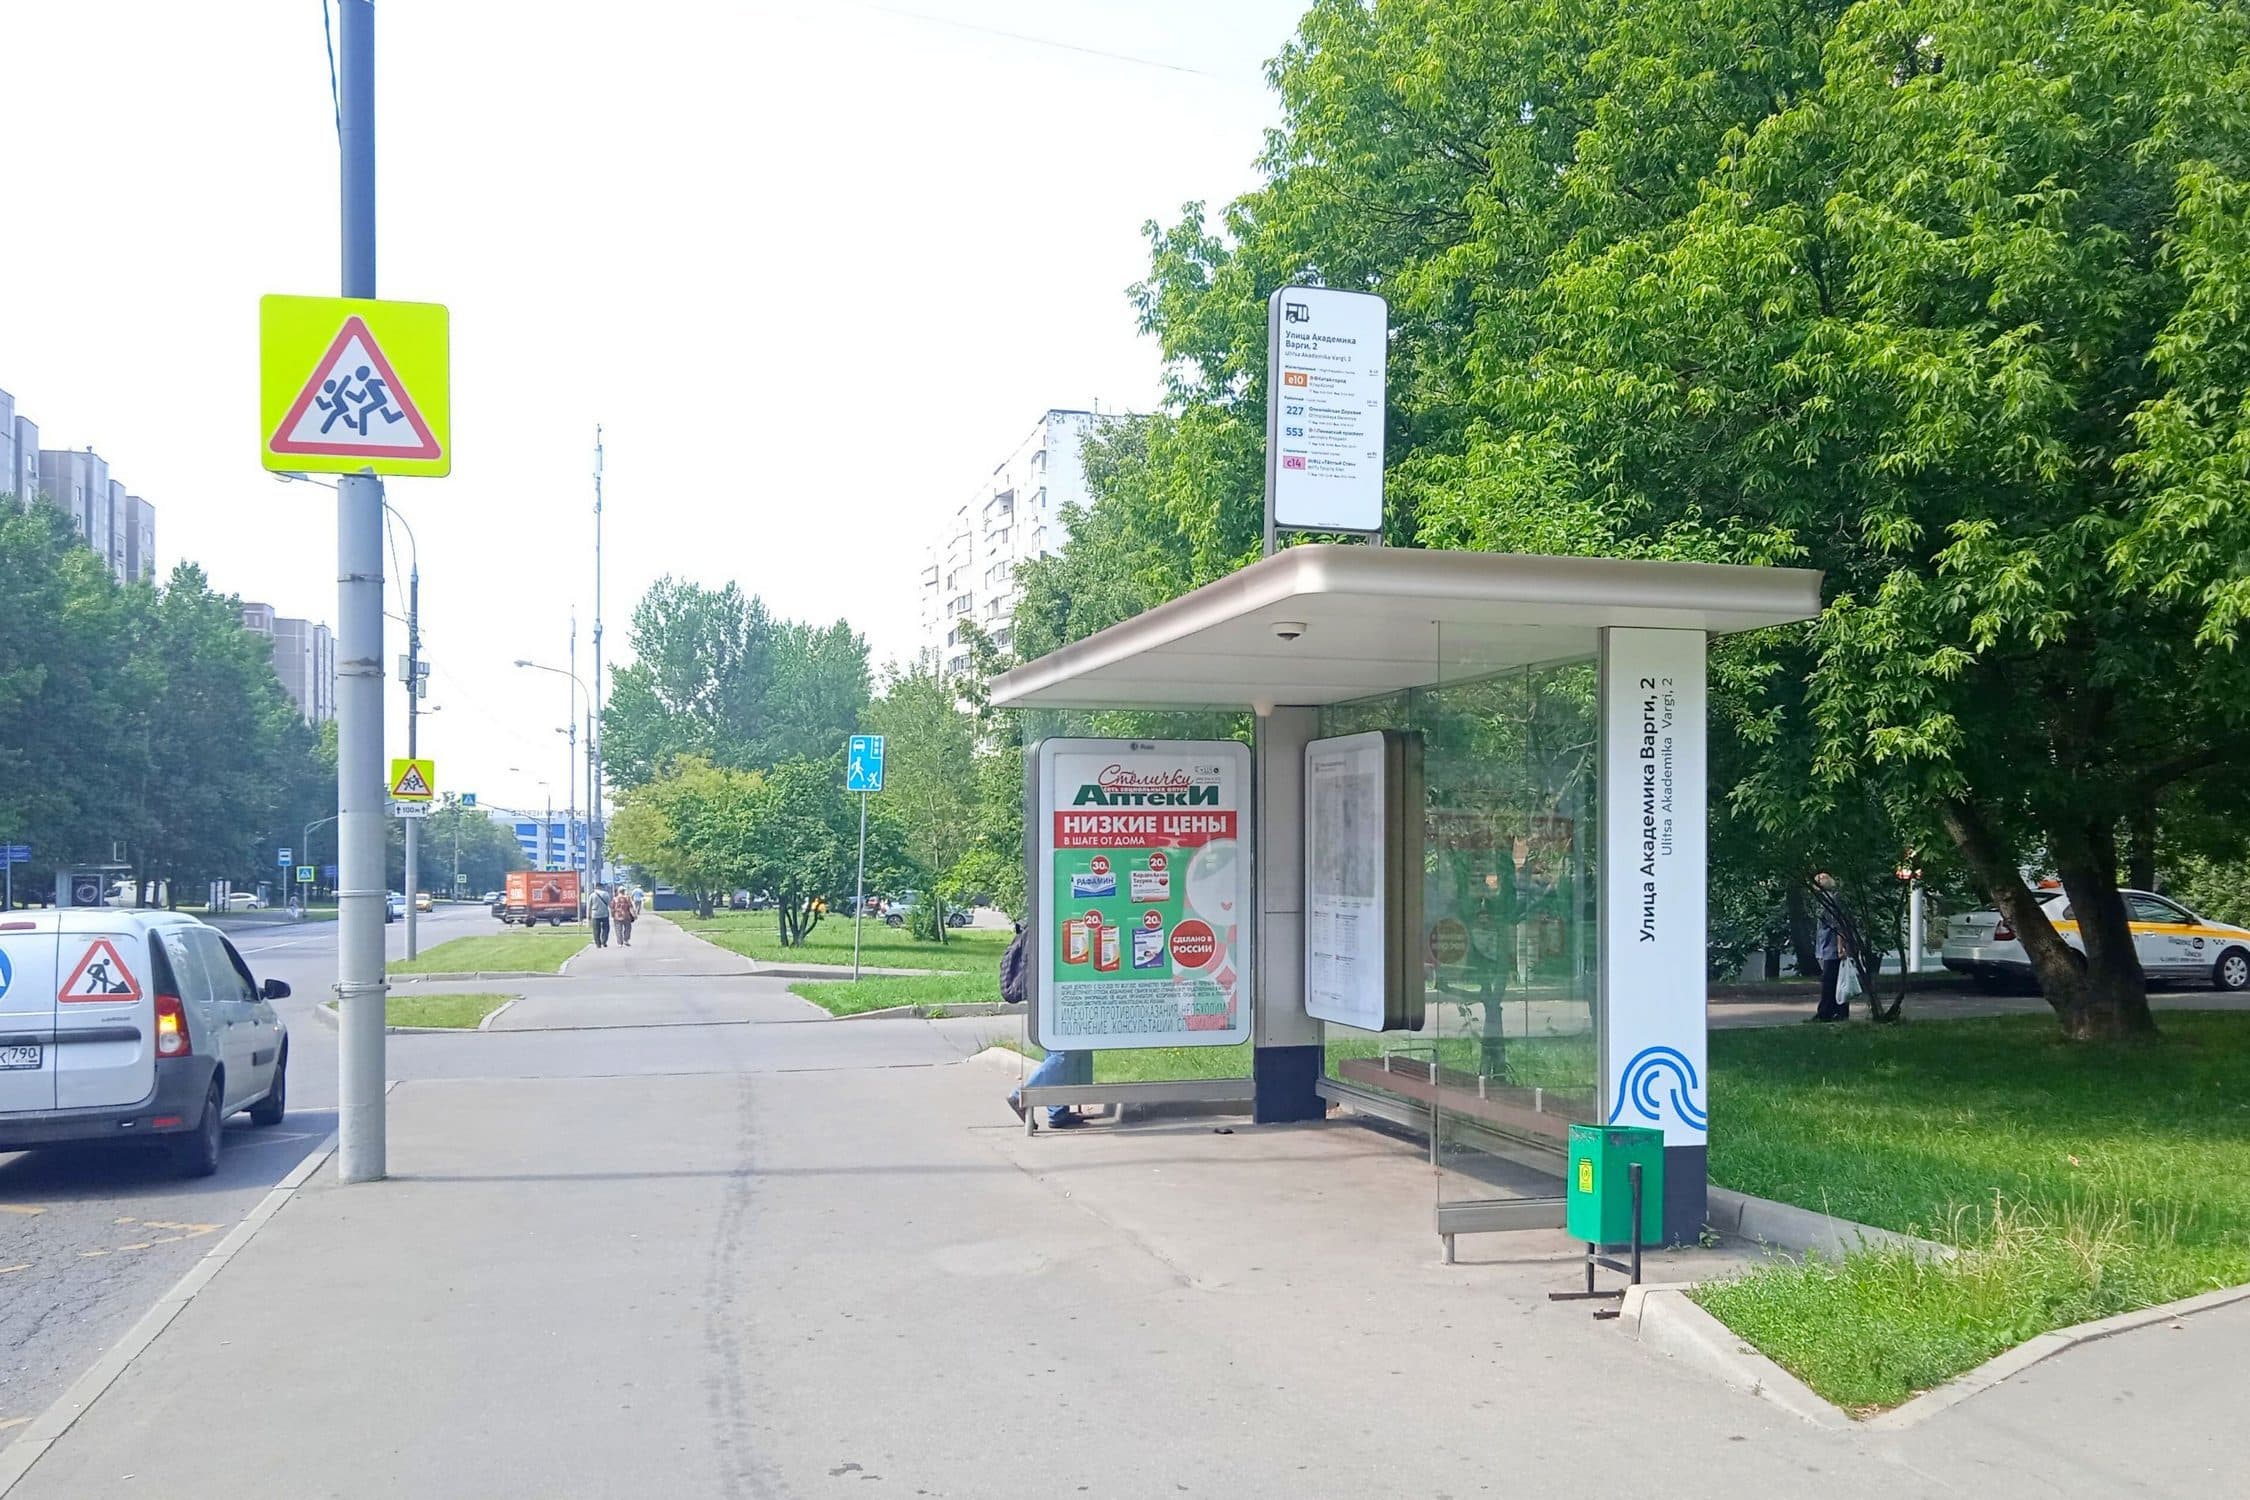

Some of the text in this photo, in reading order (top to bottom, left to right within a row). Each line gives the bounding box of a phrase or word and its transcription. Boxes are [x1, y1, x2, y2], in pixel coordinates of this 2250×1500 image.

[1285, 330, 1357, 345] Улица Академика
[1312, 342, 1318, 350] 2
[1286, 405, 1304, 416] 227
[1286, 427, 1304, 437] 553
[1661, 677, 1675, 855] Ulitsa Akademika Vargi, 2
[1098, 764, 1195, 786] Столички
[1640, 677, 1658, 942] Улица Академика Варги, 2
[1064, 815, 1227, 835] НИЗКИЕ ЦЕНЫ
[1064, 836, 1145, 846] В ШАГЕ ОТ ДОМА
[1076, 877, 1114, 886] РАФАМИН
[1173, 945, 1213, 954] РОССИИ
[11, 1047, 37, 1060] 790
